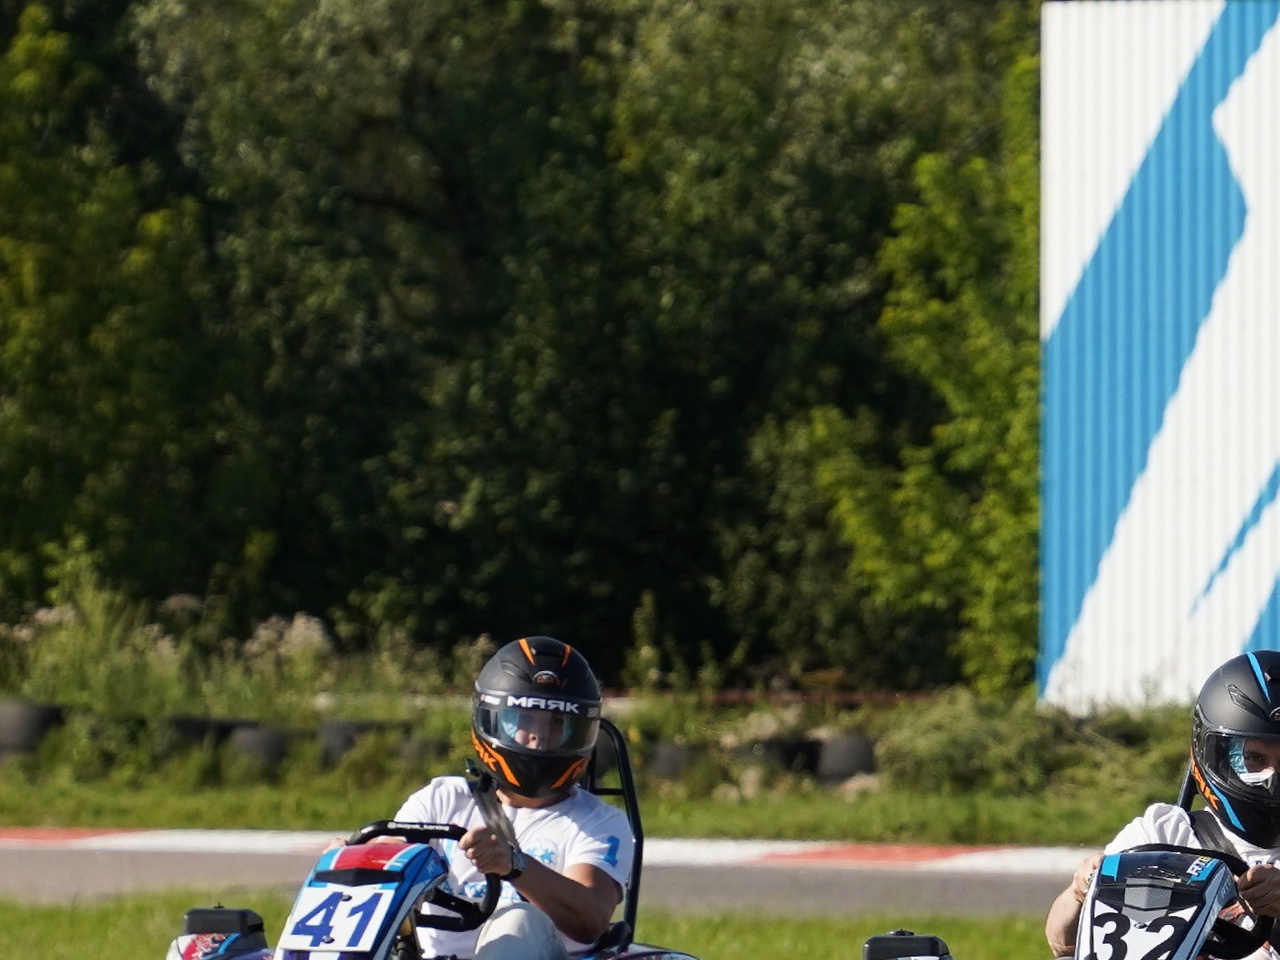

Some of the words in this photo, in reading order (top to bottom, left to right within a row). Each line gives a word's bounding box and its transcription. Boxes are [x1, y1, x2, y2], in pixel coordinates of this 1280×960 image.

[506, 695, 580, 714] МАЯК
[601, 835, 620, 868] 1
[290, 892, 383, 947] 41
